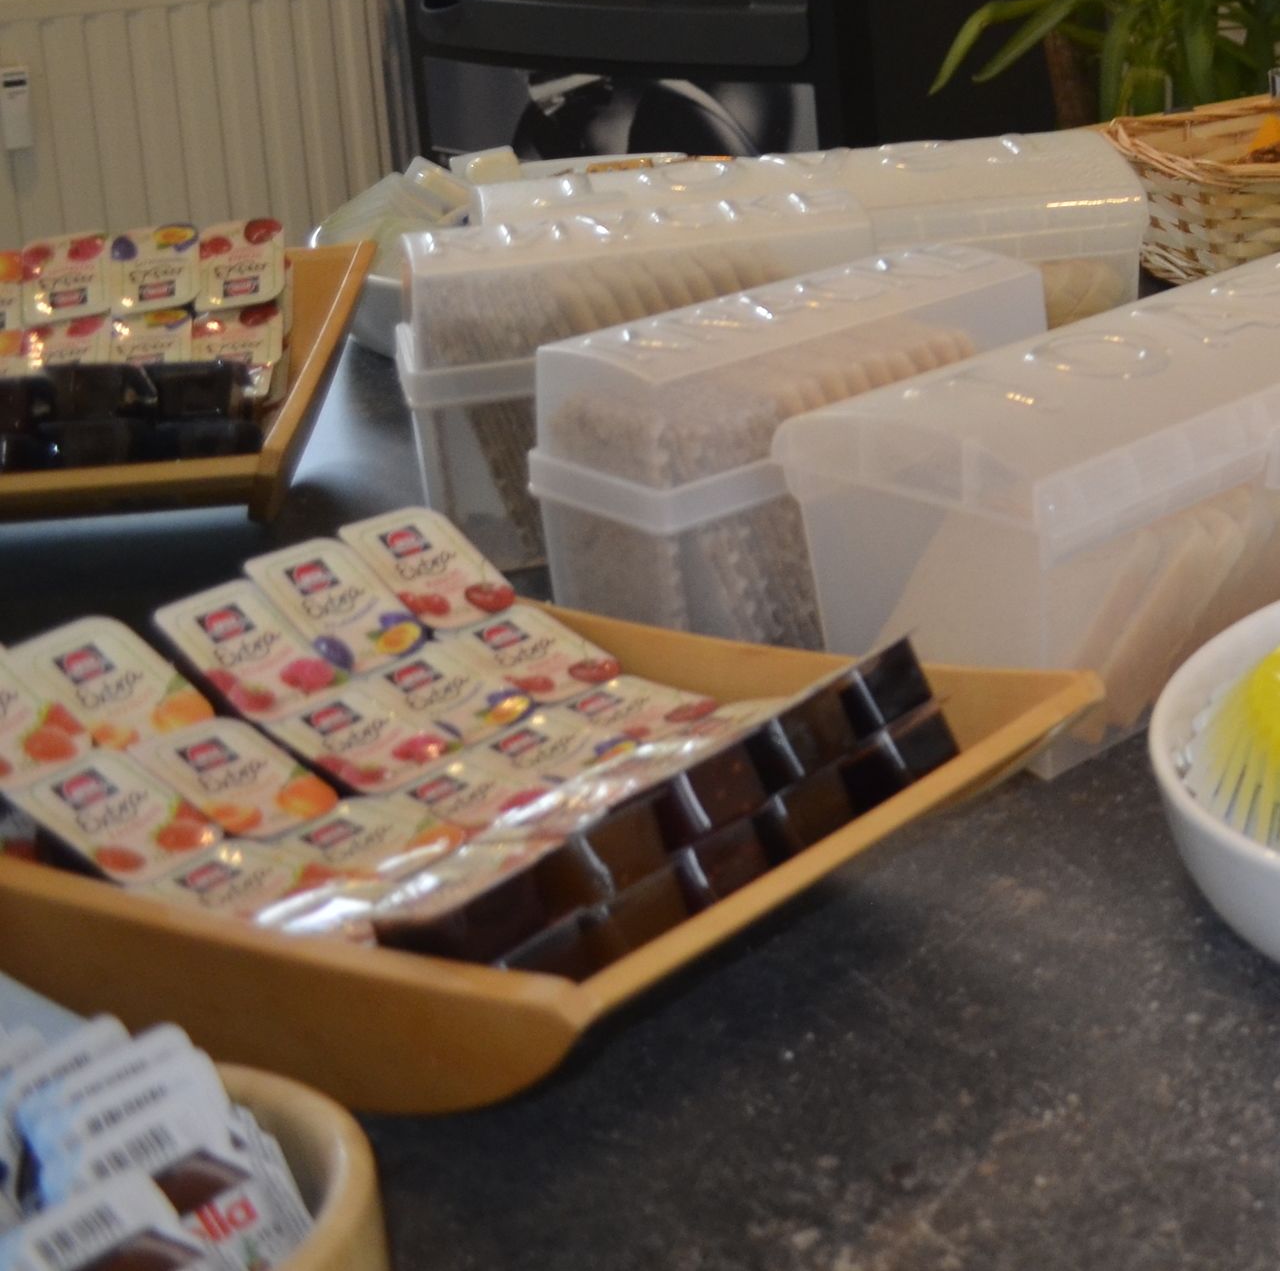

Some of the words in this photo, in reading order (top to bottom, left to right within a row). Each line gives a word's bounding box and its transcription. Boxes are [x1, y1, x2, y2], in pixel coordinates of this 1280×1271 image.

[395, 550, 457, 580] Extra
[302, 587, 364, 619] Extra
[213, 630, 281, 668] Extra
[76, 669, 143, 710] Extra
[201, 758, 268, 793] Extra
[75, 790, 149, 832] Extra
